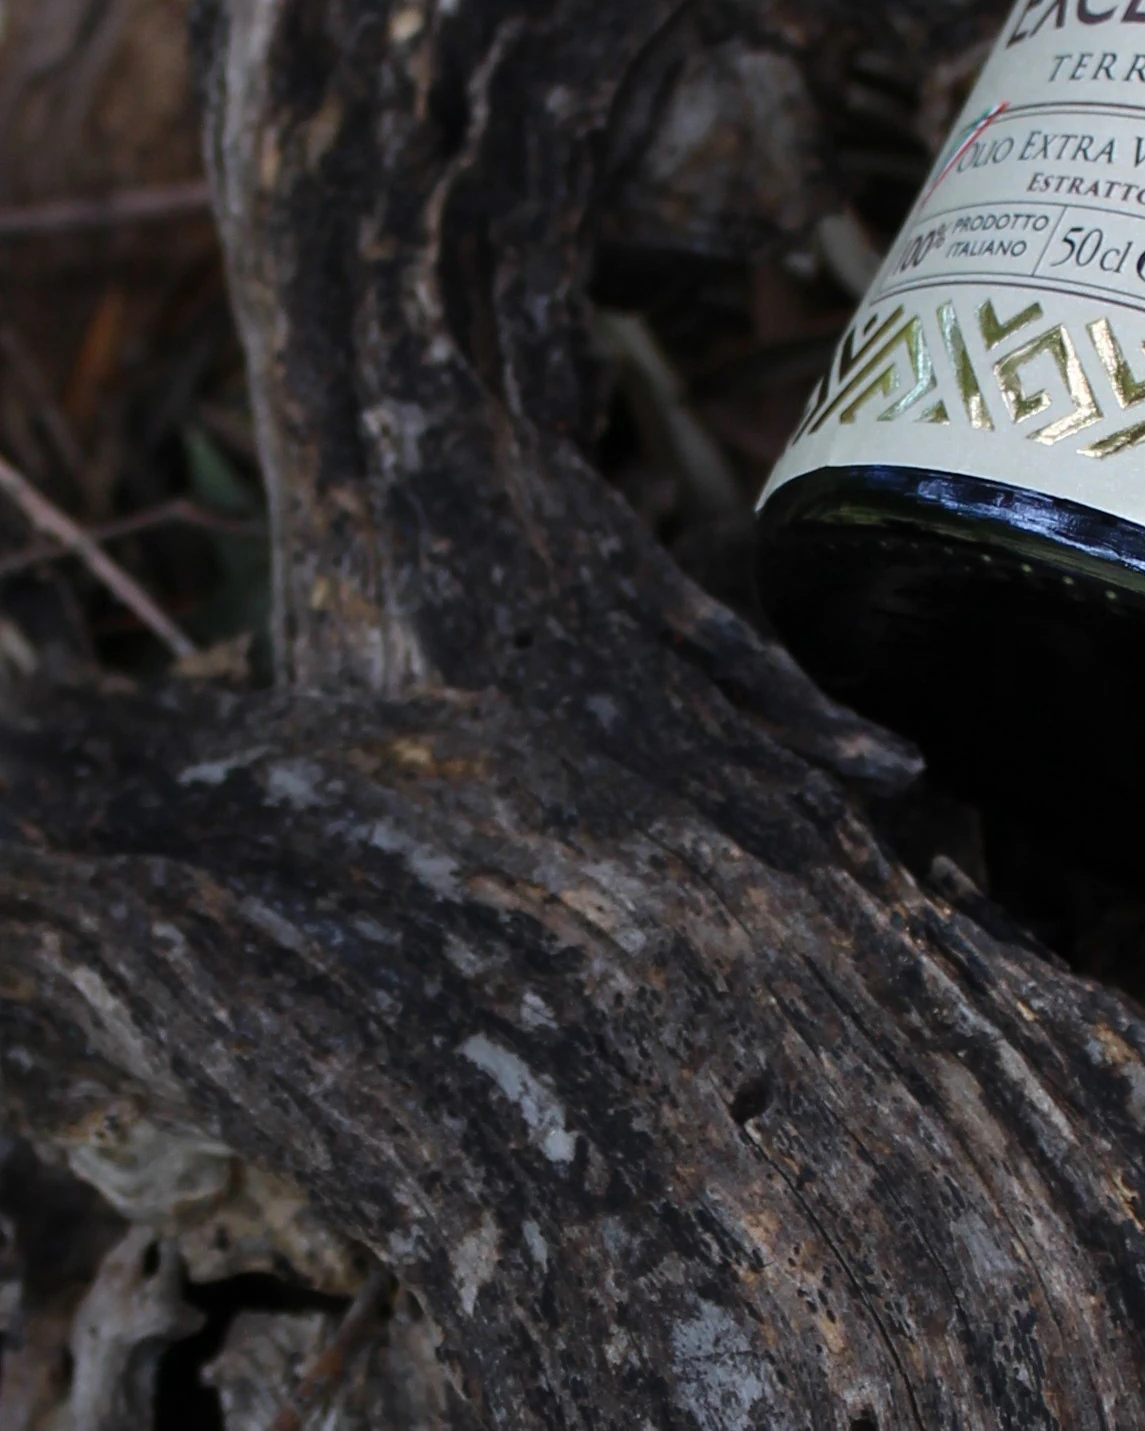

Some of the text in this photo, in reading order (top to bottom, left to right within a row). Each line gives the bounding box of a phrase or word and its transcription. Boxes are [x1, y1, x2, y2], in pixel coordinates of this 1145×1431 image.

[1018, 131, 1116, 165] EXTRA
[951, 213, 1051, 234] PRODOTTO
[945, 239, 1028, 259] ITALIANO
[1050, 226, 1134, 274] 50cl
